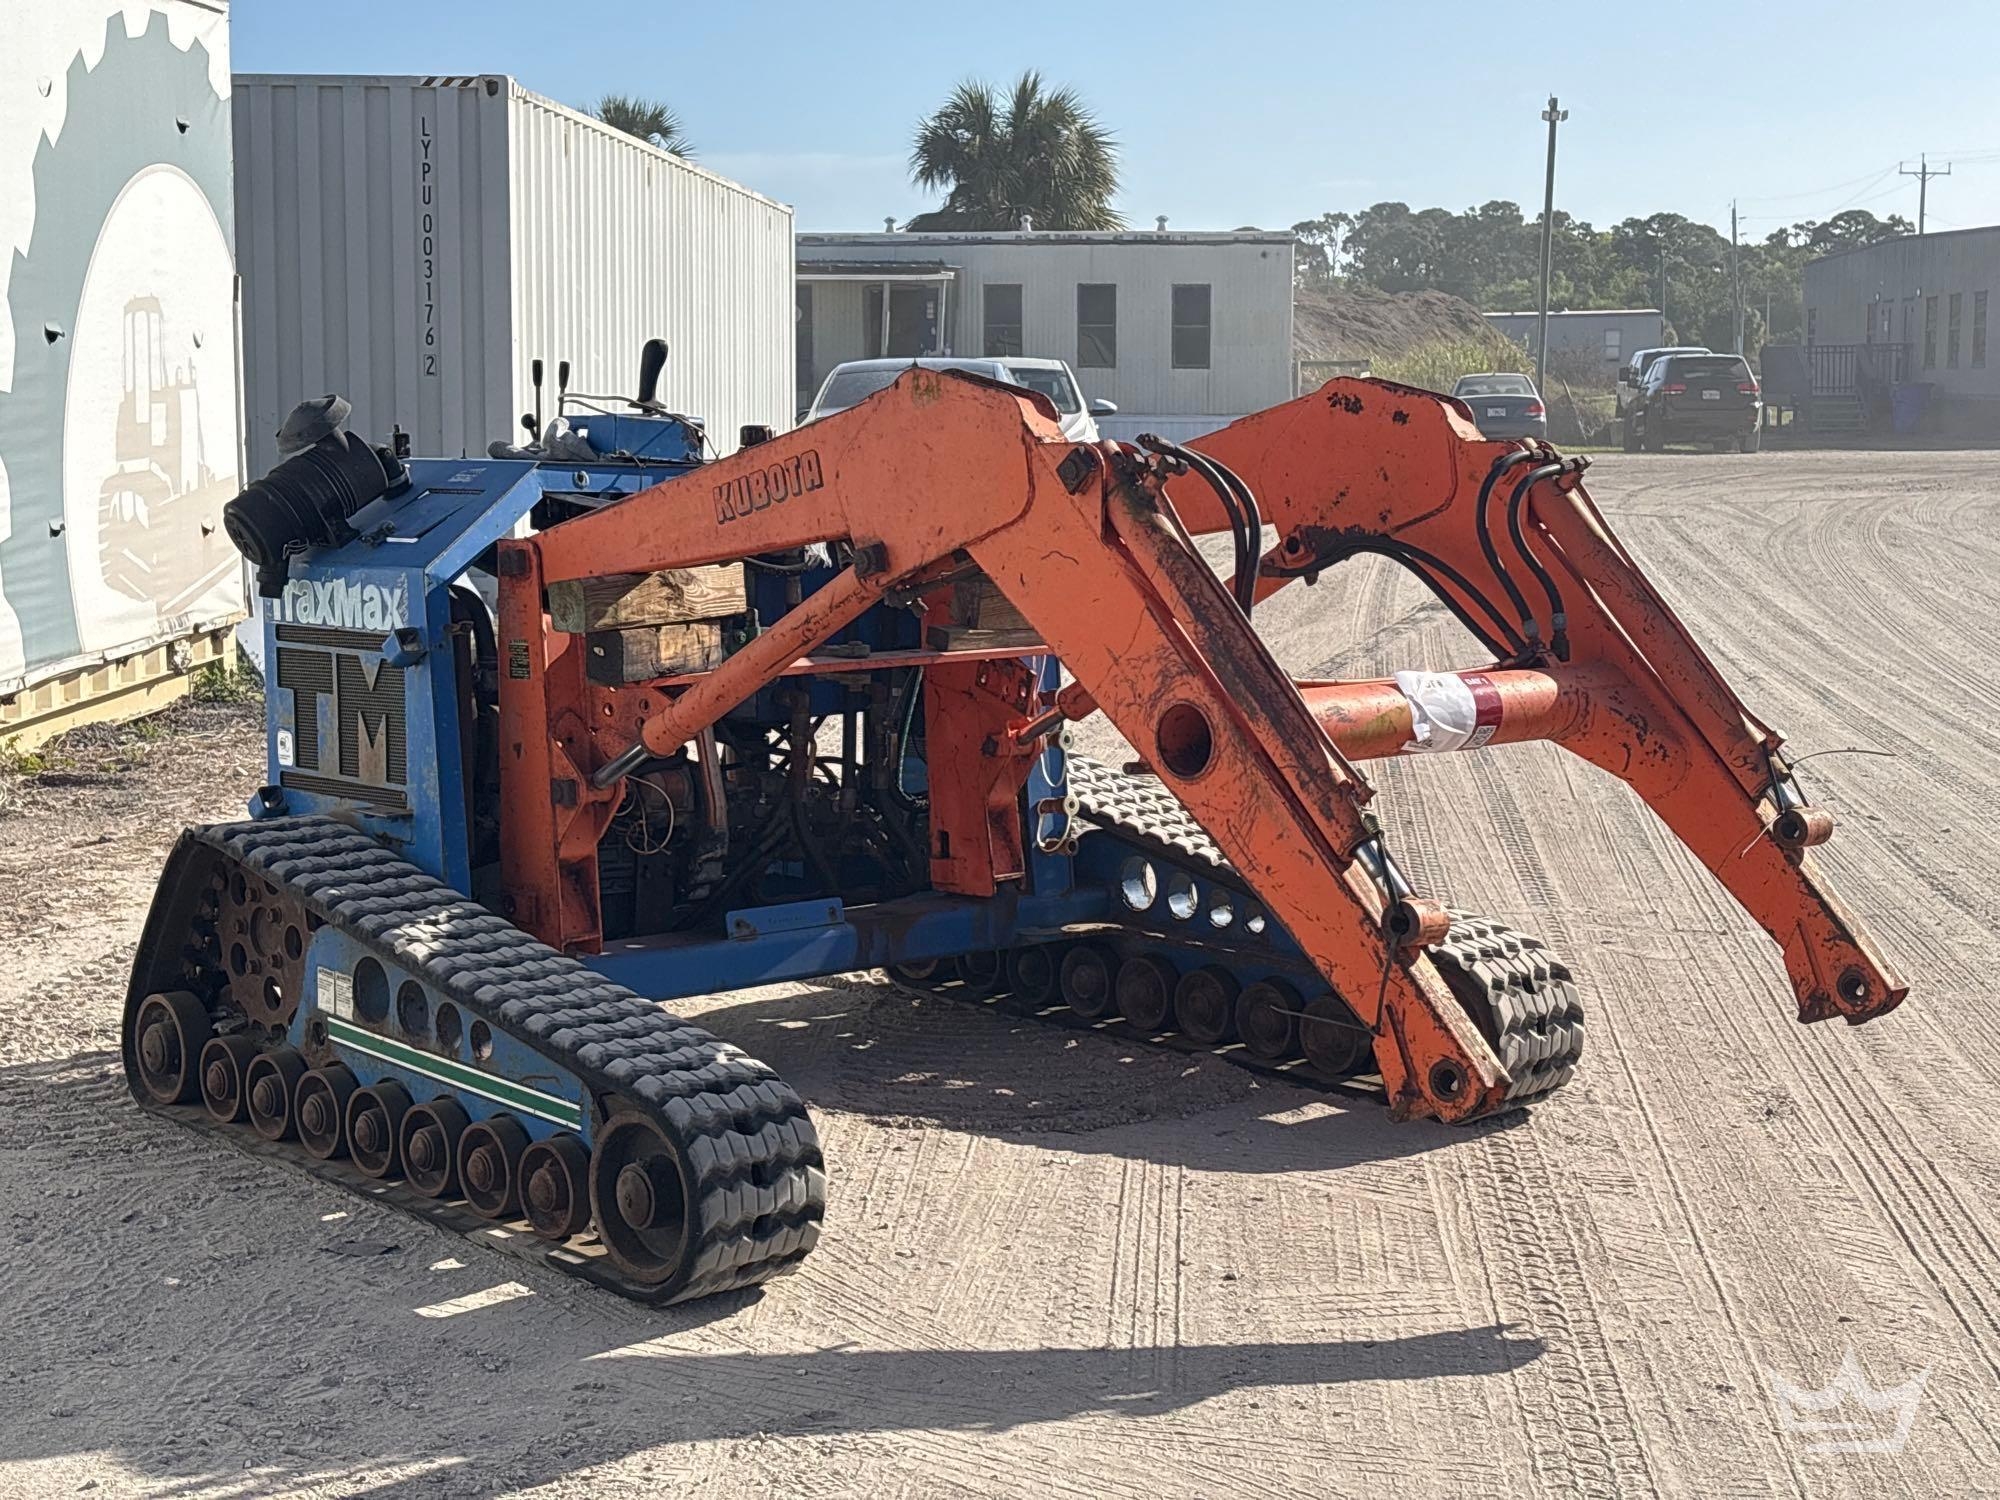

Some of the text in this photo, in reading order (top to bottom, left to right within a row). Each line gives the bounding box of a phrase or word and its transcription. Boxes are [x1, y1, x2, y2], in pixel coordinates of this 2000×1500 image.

[420, 116, 436, 376] LYPU 003176 2
[713, 449, 824, 525] KUBOTA
[277, 647, 408, 786] TM
